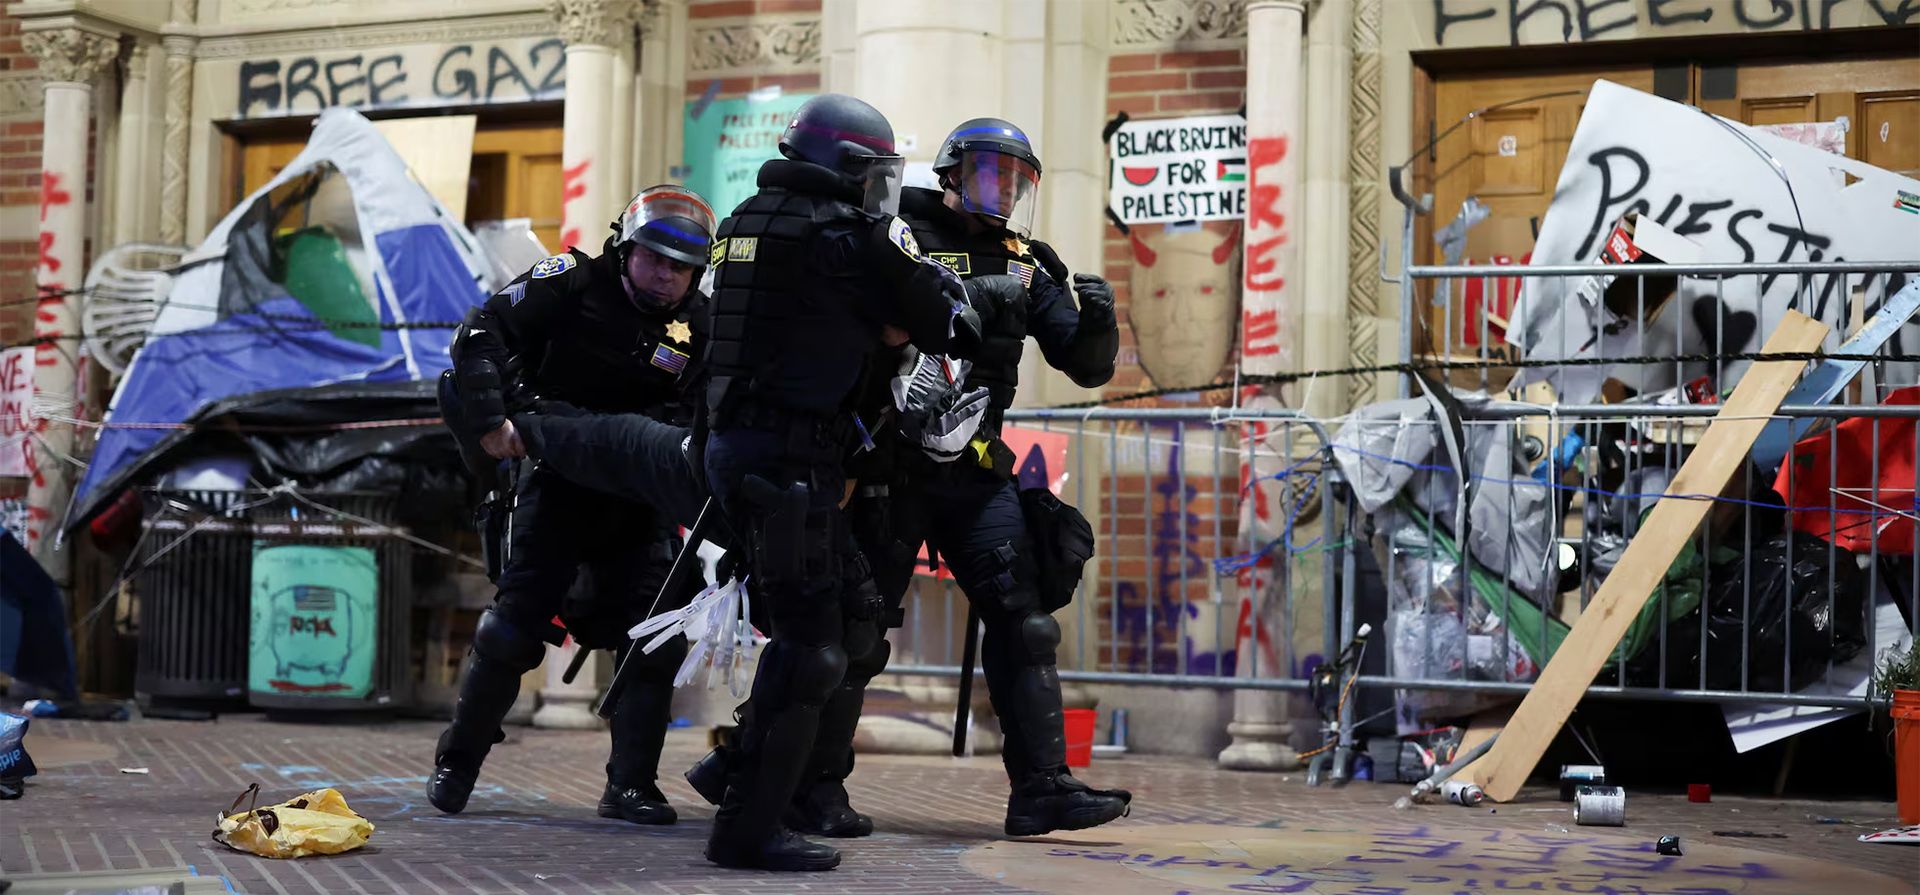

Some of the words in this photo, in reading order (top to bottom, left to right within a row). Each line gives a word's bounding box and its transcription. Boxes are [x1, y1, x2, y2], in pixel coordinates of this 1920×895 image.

[237, 53, 408, 117] FREE
[432, 39, 565, 101] GAZ
[1117, 128, 1176, 158] BLACK
[1167, 159, 1207, 186] FOR
[1122, 188, 1246, 220] PALESTINE
[940, 256, 958, 265] CHP
[1244, 136, 1288, 358] FREE
